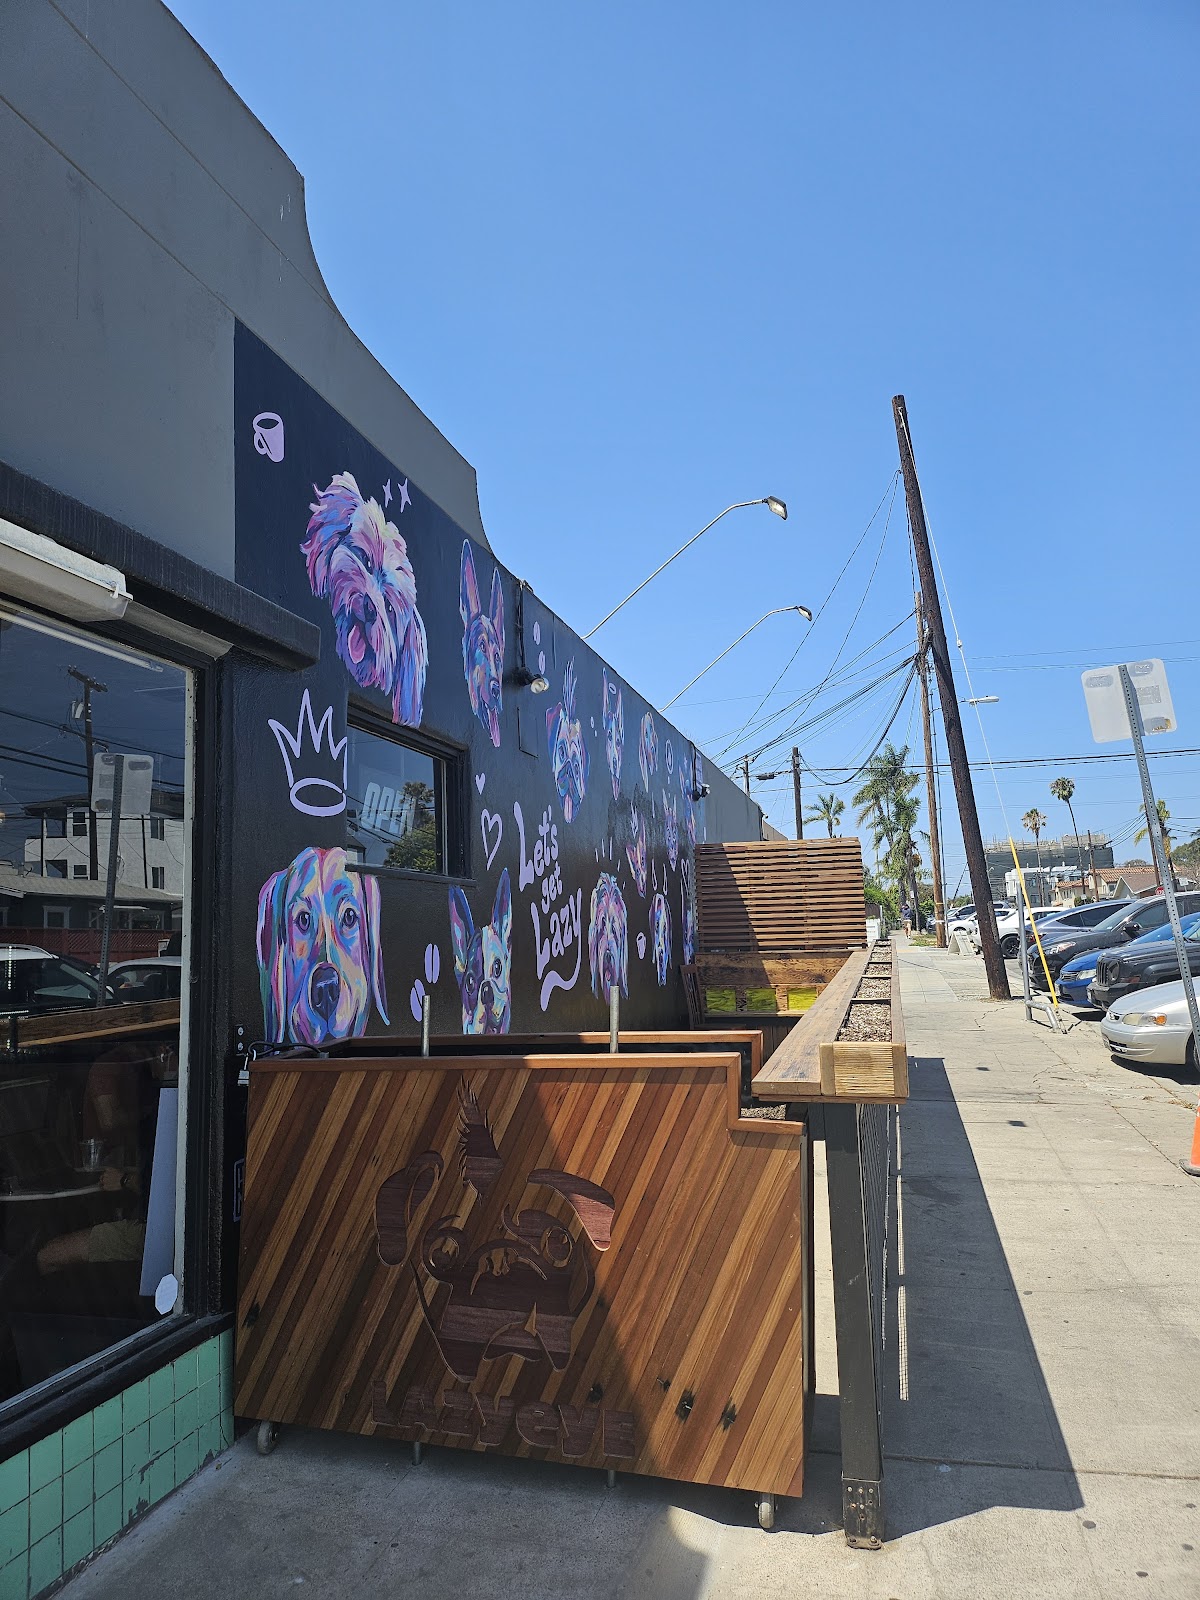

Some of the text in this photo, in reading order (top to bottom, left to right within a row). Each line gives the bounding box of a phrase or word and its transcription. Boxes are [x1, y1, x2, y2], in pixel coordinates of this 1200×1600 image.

[361, 782, 415, 836] OPEN
[514, 802, 558, 892] Let's
[542, 863, 562, 914] get
[530, 888, 582, 1011] Lazy
